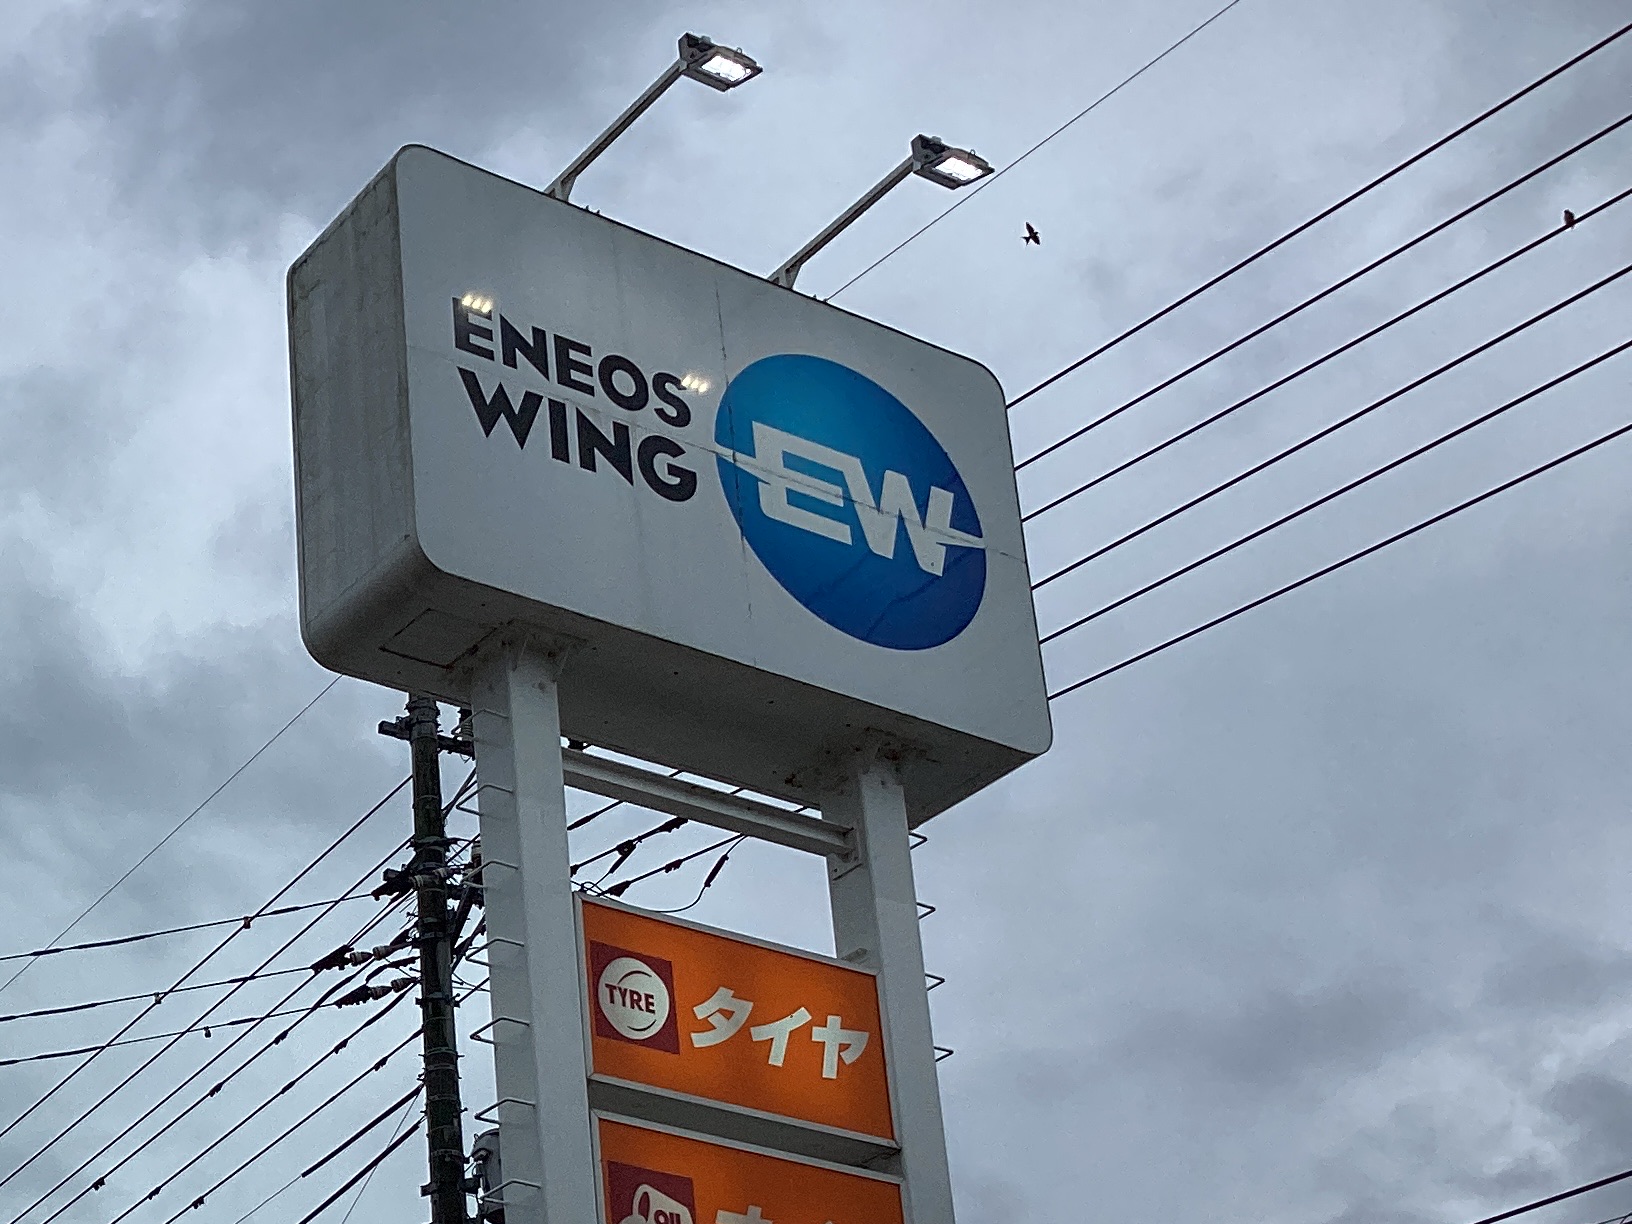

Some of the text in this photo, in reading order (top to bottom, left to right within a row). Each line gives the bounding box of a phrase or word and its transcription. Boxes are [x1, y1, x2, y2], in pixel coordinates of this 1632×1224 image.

[452, 297, 693, 428] ENEOS
[458, 367, 697, 502] WING
[605, 983, 656, 1014] TYRE
[690, 987, 869, 1079] タイヤ
